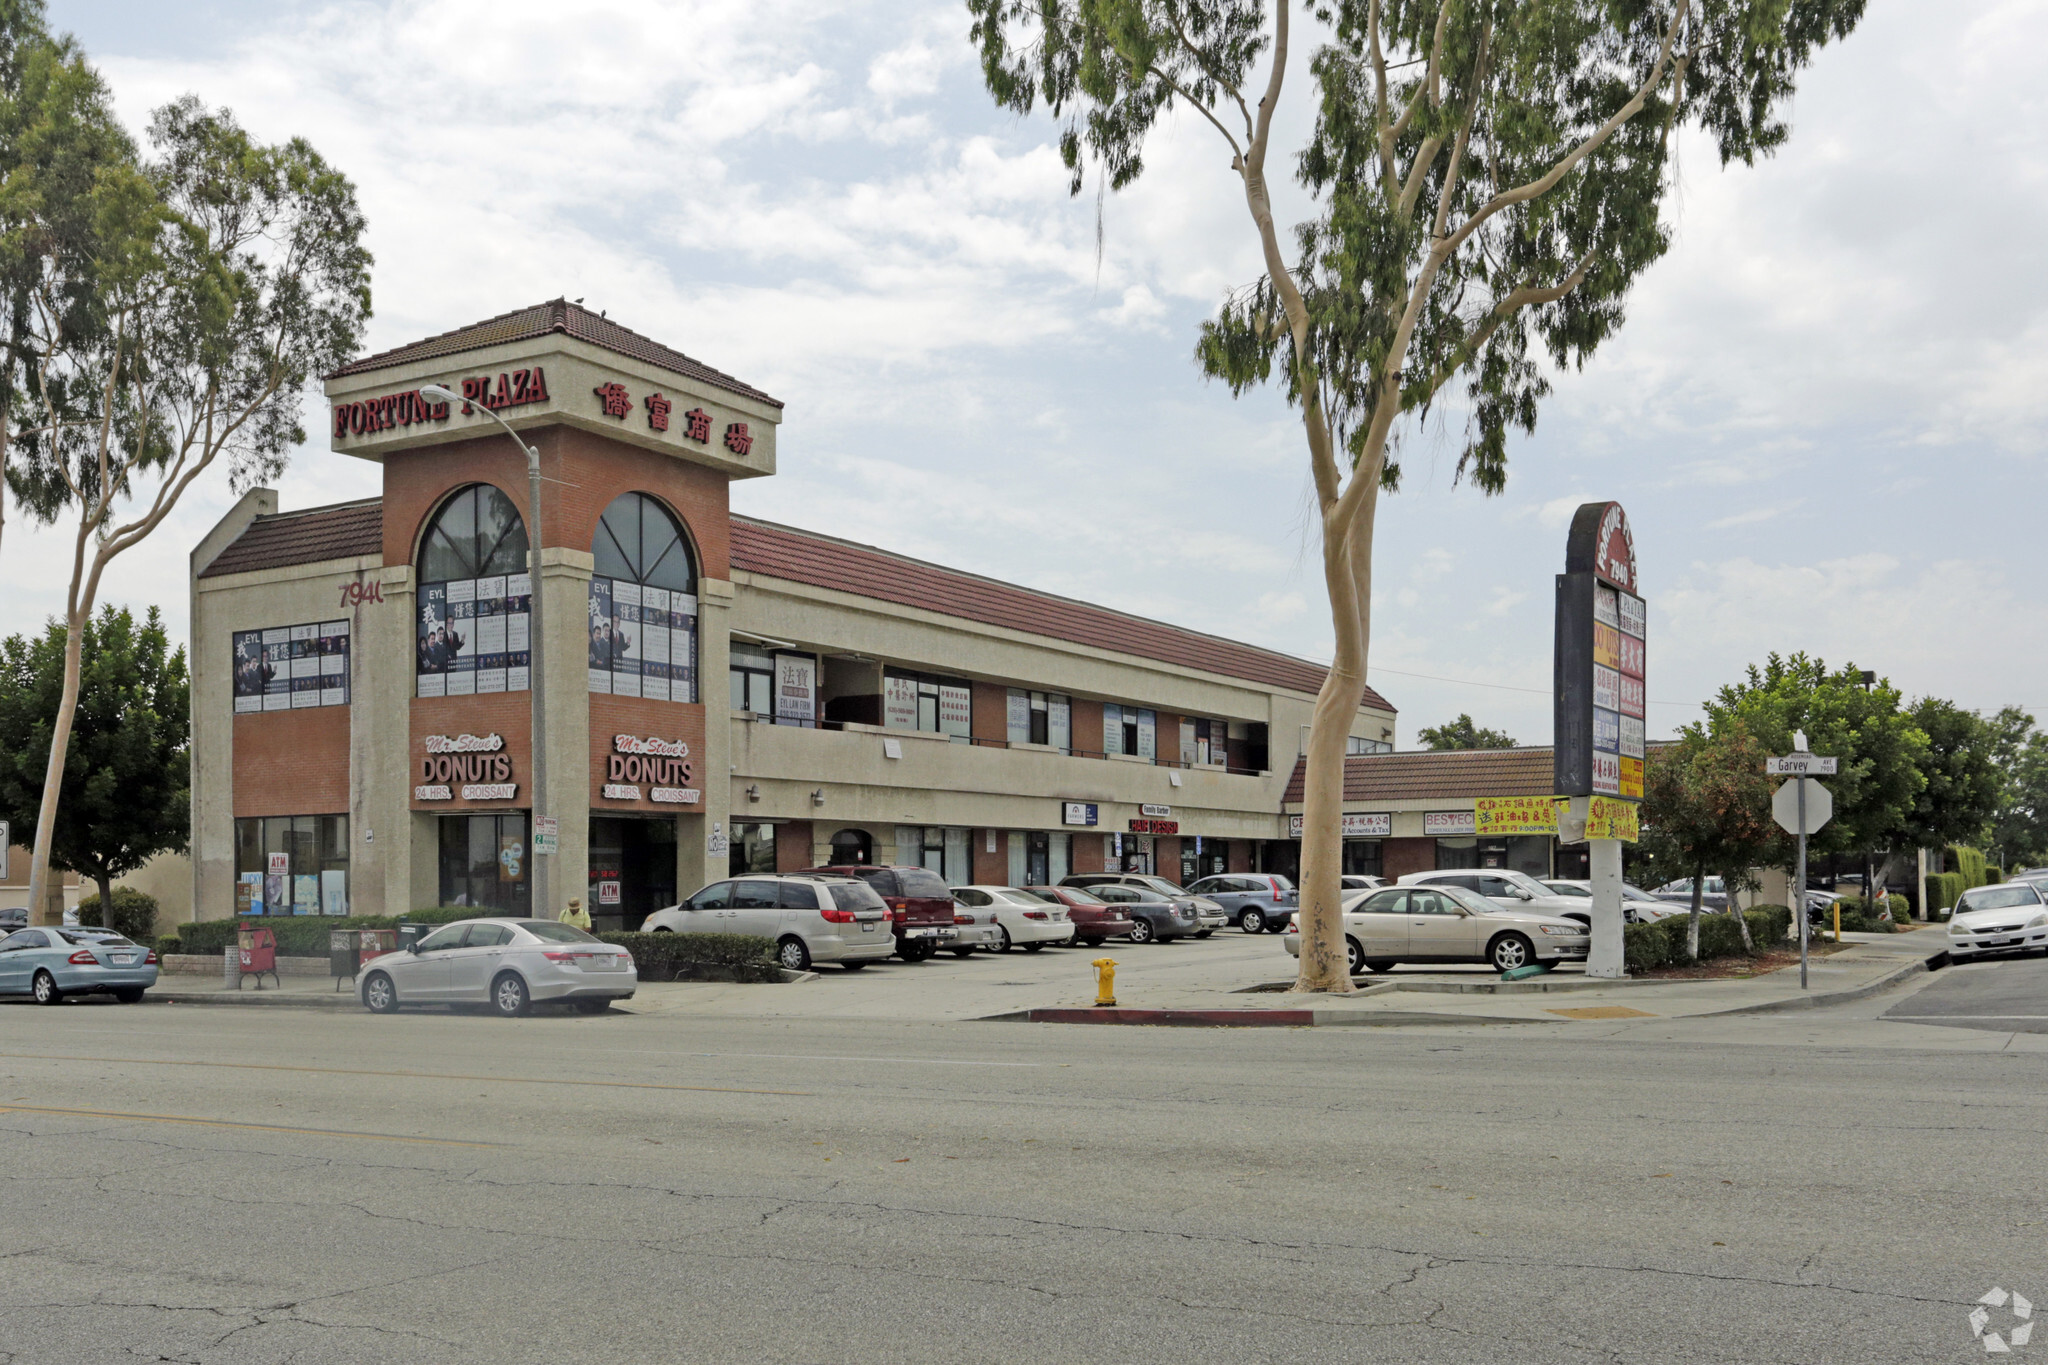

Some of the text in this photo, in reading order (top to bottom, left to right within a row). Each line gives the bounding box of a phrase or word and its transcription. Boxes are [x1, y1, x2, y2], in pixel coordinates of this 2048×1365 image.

[461, 366, 550, 415] PLAZA
[593, 381, 754, 456] 僑富商場
[1597, 505, 1621, 572] FORTUNE
[1610, 559, 1628, 586] 7940
[429, 589, 445, 599] EYL
[594, 583, 610, 595] EYL
[245, 633, 260, 644] EYL
[426, 735, 501, 751] Mr. Steve's
[617, 736, 687, 754] Mr. Steve's
[420, 753, 511, 781] DONUTS
[610, 755, 694, 785] DONUTS
[1778, 759, 1808, 772] Garvey
[415, 787, 450, 798] 24 HRS.
[463, 786, 515, 798] CROISSANT
[606, 786, 640, 798] 24 HRS.
[652, 789, 699, 801] CROISSANT
[1144, 805, 1156, 815] Family
[1152, 820, 1178, 834] DESIGN
[272, 856, 286, 868] ATM
[602, 884, 618, 897] ATM
